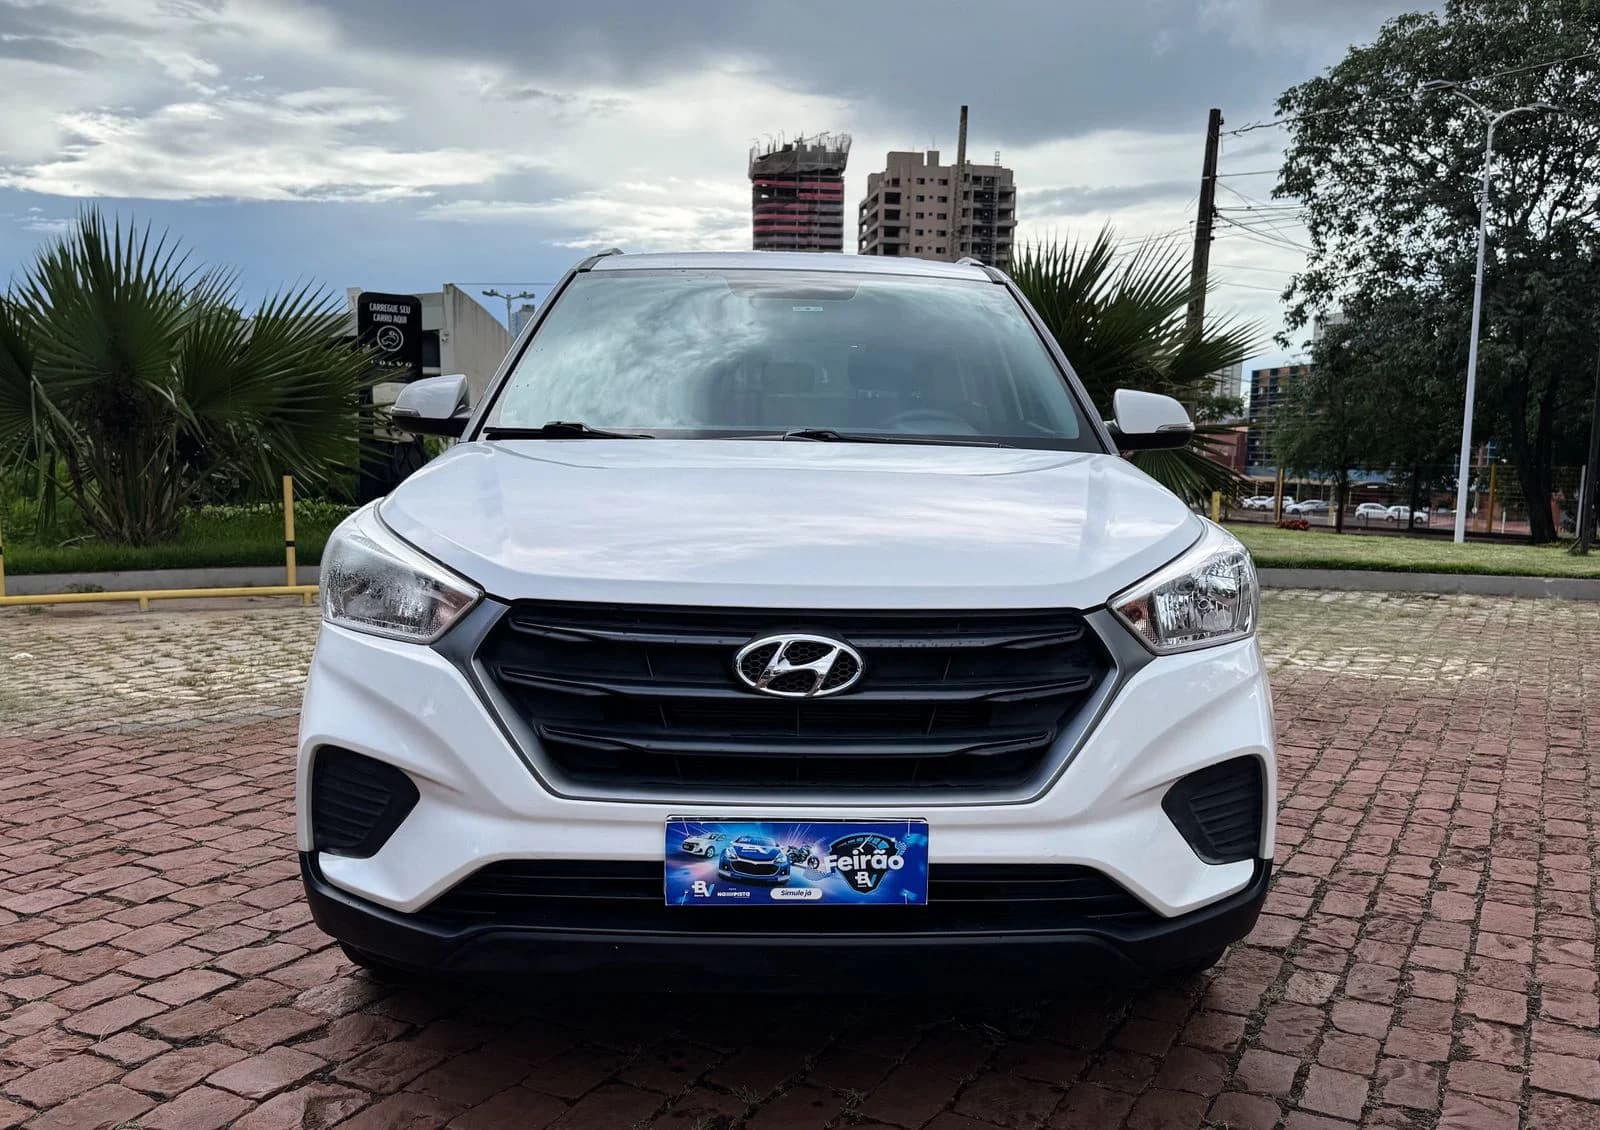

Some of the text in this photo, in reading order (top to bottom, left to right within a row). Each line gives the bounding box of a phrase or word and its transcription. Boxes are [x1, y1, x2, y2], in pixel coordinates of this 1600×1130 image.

[369, 302, 411, 314] CARREGUE SEU
[373, 313, 407, 324] CARRO AQUI
[824, 849, 905, 873] Feirão
[804, 889, 812, 898] já
